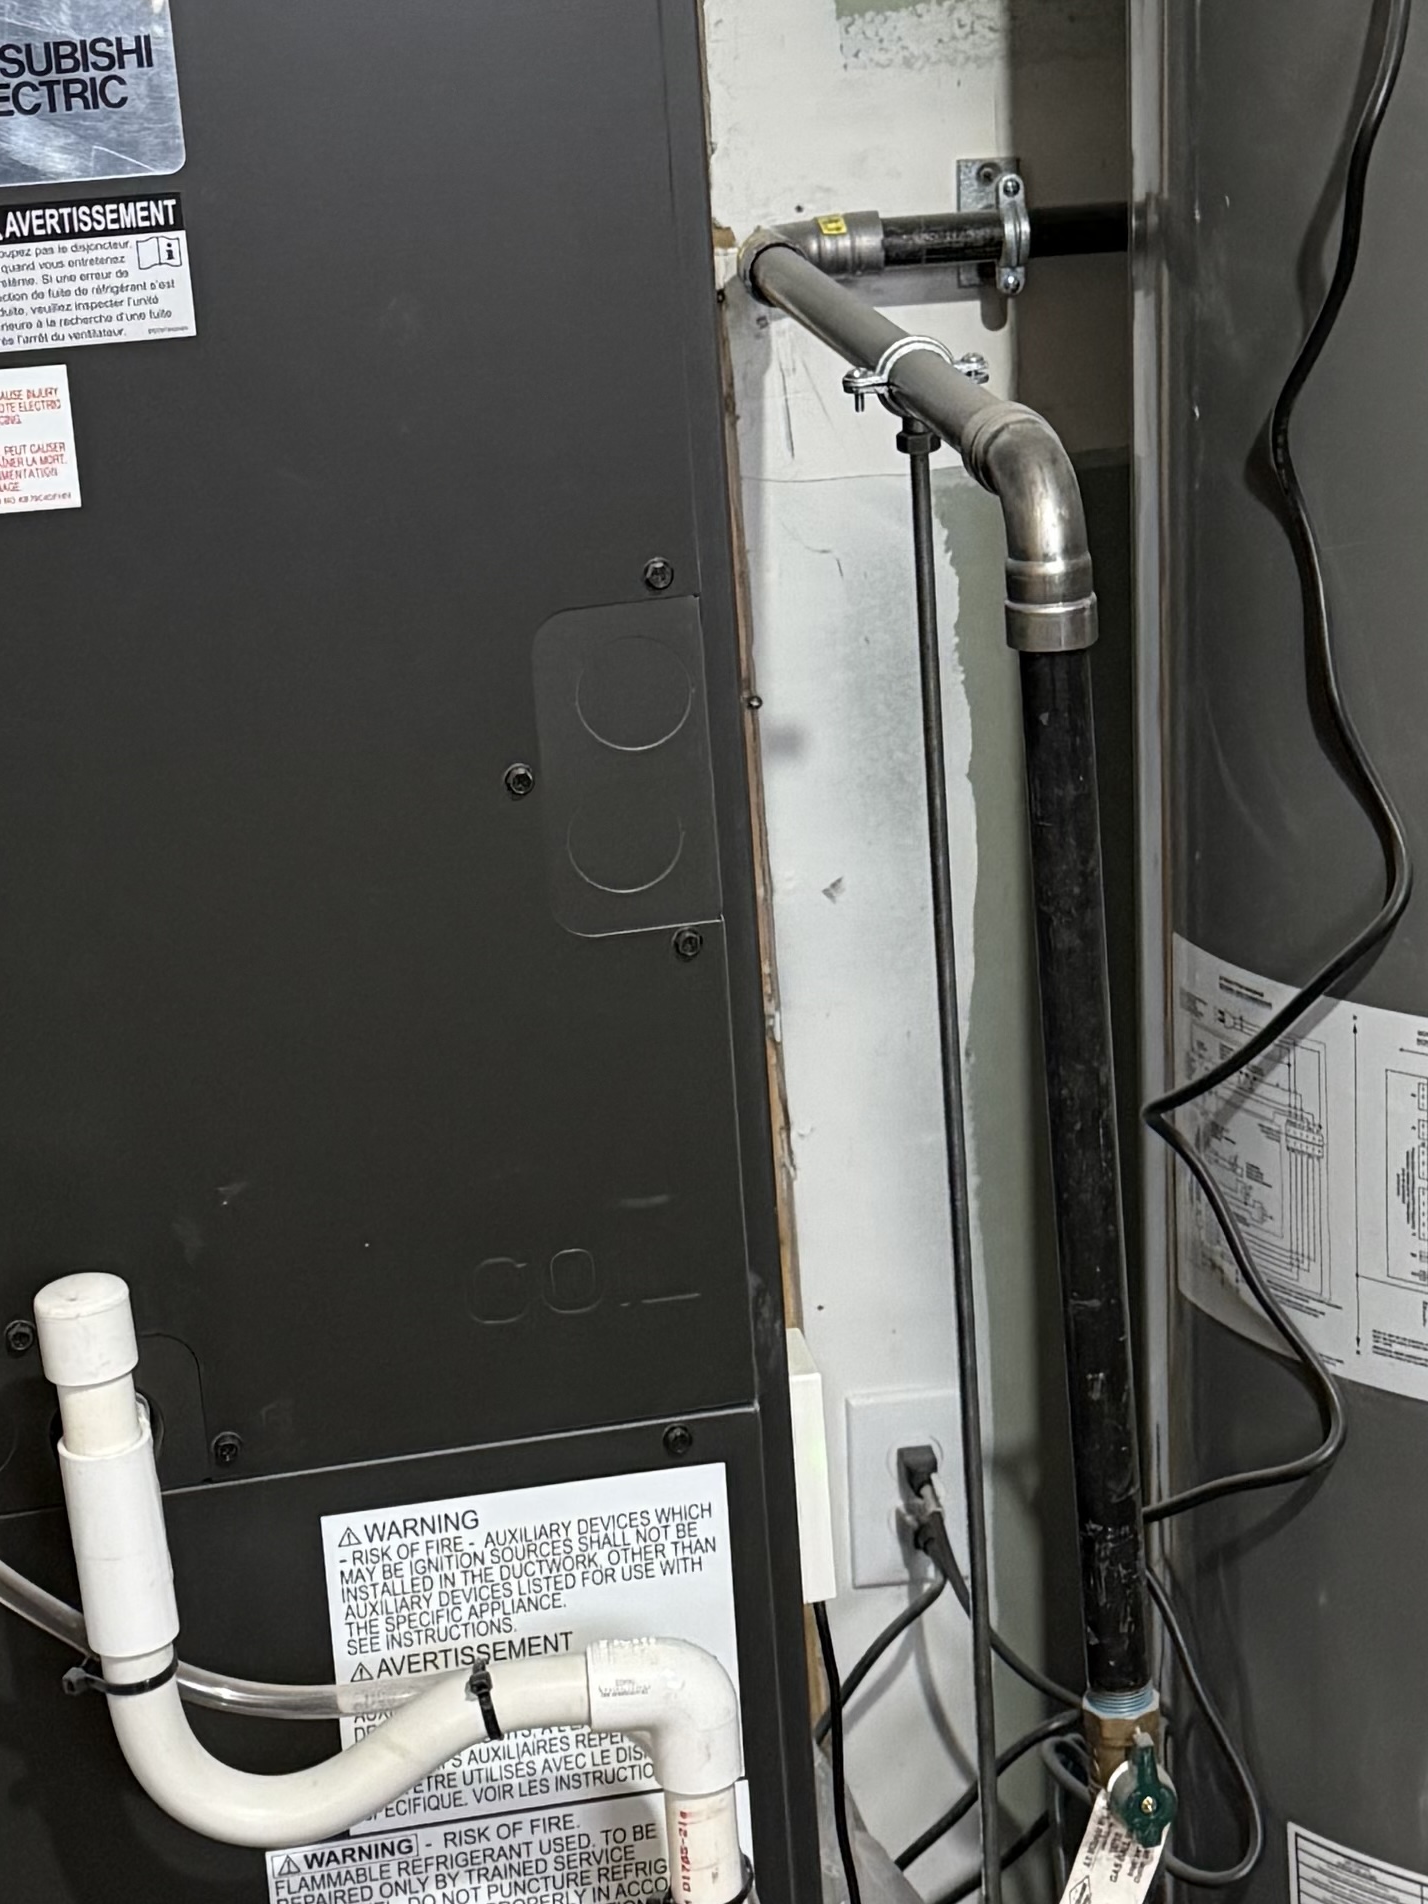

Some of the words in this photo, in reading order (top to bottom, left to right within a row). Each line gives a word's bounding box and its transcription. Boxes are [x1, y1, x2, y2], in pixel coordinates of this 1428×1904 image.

[2, 198, 178, 237] AVERTISSEMENT
[339, 1565, 375, 1586] MAY
[382, 1562, 404, 1580] BE
[409, 1551, 484, 1576] IGNITION
[489, 1538, 573, 1565] SOURCES
[578, 1530, 630, 1553] SHALL
[635, 1524, 670, 1545] NOT
[676, 1521, 697, 1539] BE
[351, 1545, 392, 1567] RISK
[396, 1541, 420, 1560] OF
[425, 1535, 463, 1556] FIRE
[484, 1520, 571, 1548] AUXILIARY
[577, 1510, 650, 1536] DEVICES
[655, 1501, 712, 1525] WHICH
[364, 1509, 479, 1543] WARNING
[342, 1575, 433, 1603] INSTALLED
[439, 1572, 454, 1589] IN
[460, 1567, 494, 1586] THE
[607, 1542, 665, 1566] OTHER
[669, 1536, 716, 1557] THAN
[347, 1635, 380, 1655] SEE
[385, 1617, 516, 1650] INSTRUCTIONS.
[375, 1632, 573, 1678] AVERTISSEMENT
[274, 1862, 390, 1896] FLAMMABLE
[396, 1840, 533, 1877] REFRIGERANT
[539, 1831, 594, 1856] USED.
[602, 1826, 628, 1846] TO
[632, 1822, 656, 1841] BE
[304, 1837, 414, 1870] WARNING
[443, 1825, 491, 1848] RISK
[497, 1819, 524, 1840] OF
[529, 1811, 580, 1835] FIRE.
[378, 1875, 429, 1899] ONLY
[435, 1870, 458, 1890] BY
[464, 1857, 547, 1885] TRAINED
[552, 1844, 634, 1872] SERVICE
[486, 1868, 591, 1900] PUNCTURE
